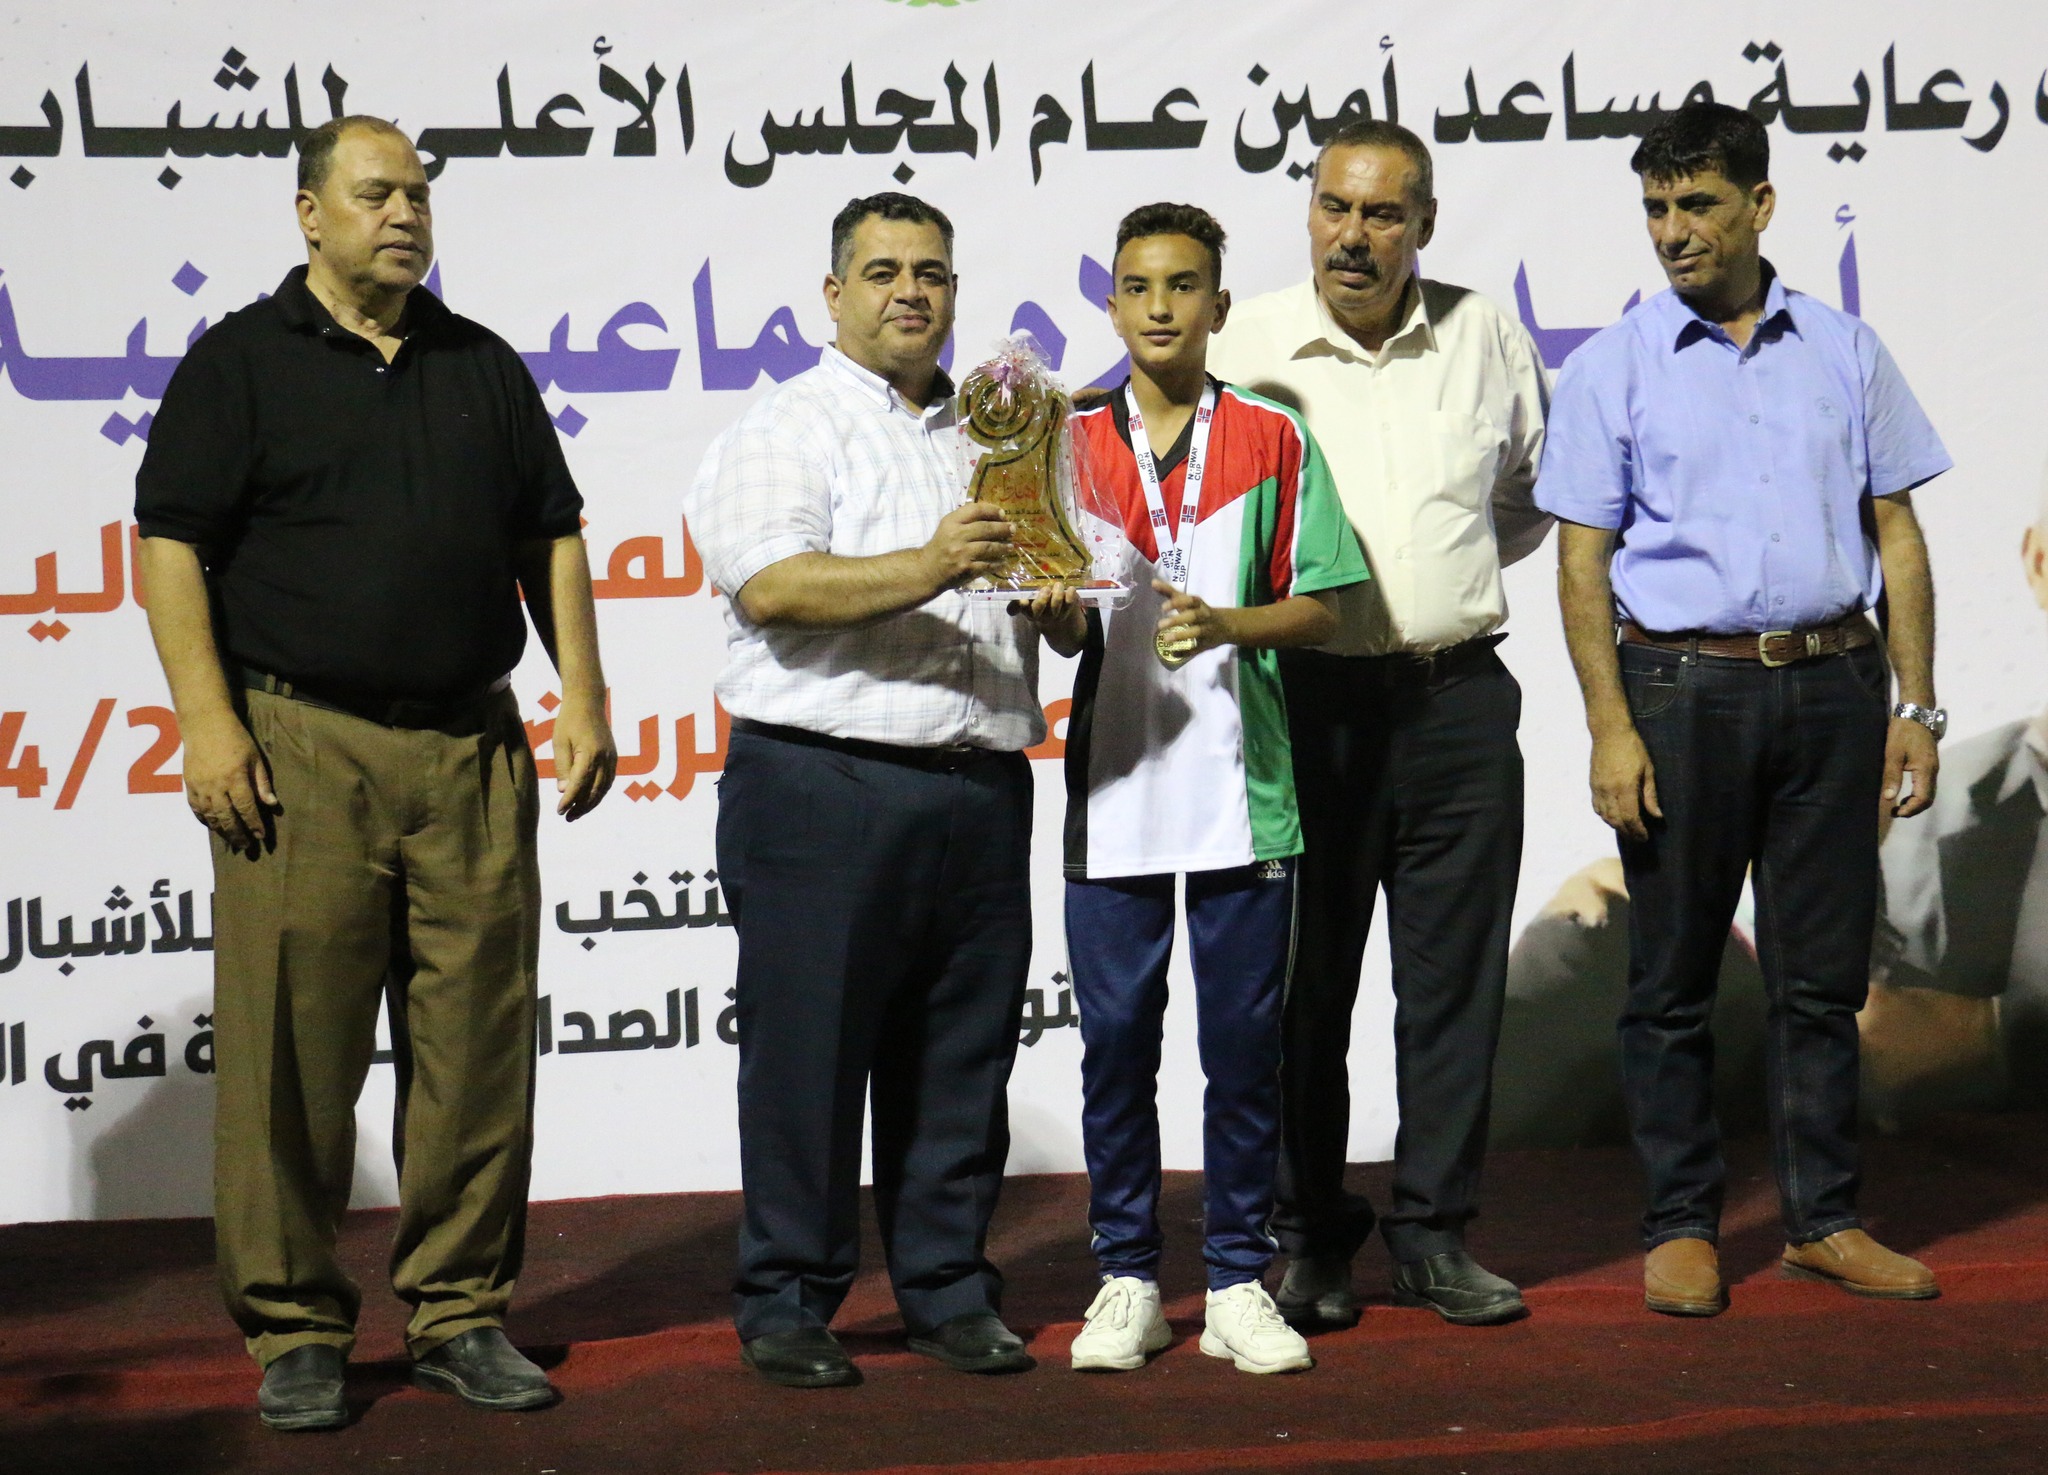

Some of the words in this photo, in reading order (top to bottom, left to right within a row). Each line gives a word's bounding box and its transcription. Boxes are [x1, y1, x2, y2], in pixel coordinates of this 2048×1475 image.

[724, 58, 1001, 189] المجلس
[1029, 58, 1208, 187] عام
[1234, 34, 1399, 182] أمين
[1433, 49, 1716, 144] مساعد
[1742, 40, 2010, 164] رعاية
[1137, 453, 1147, 470] CUP
[1194, 463, 1203, 481] CUP
[1161, 551, 1170, 569] CUP
[1179, 565, 1187, 583] CUP
[0, 878, 214, 977] لأشبال
[555, 868, 739, 952] نتخب
[44, 1014, 166, 1112] في
